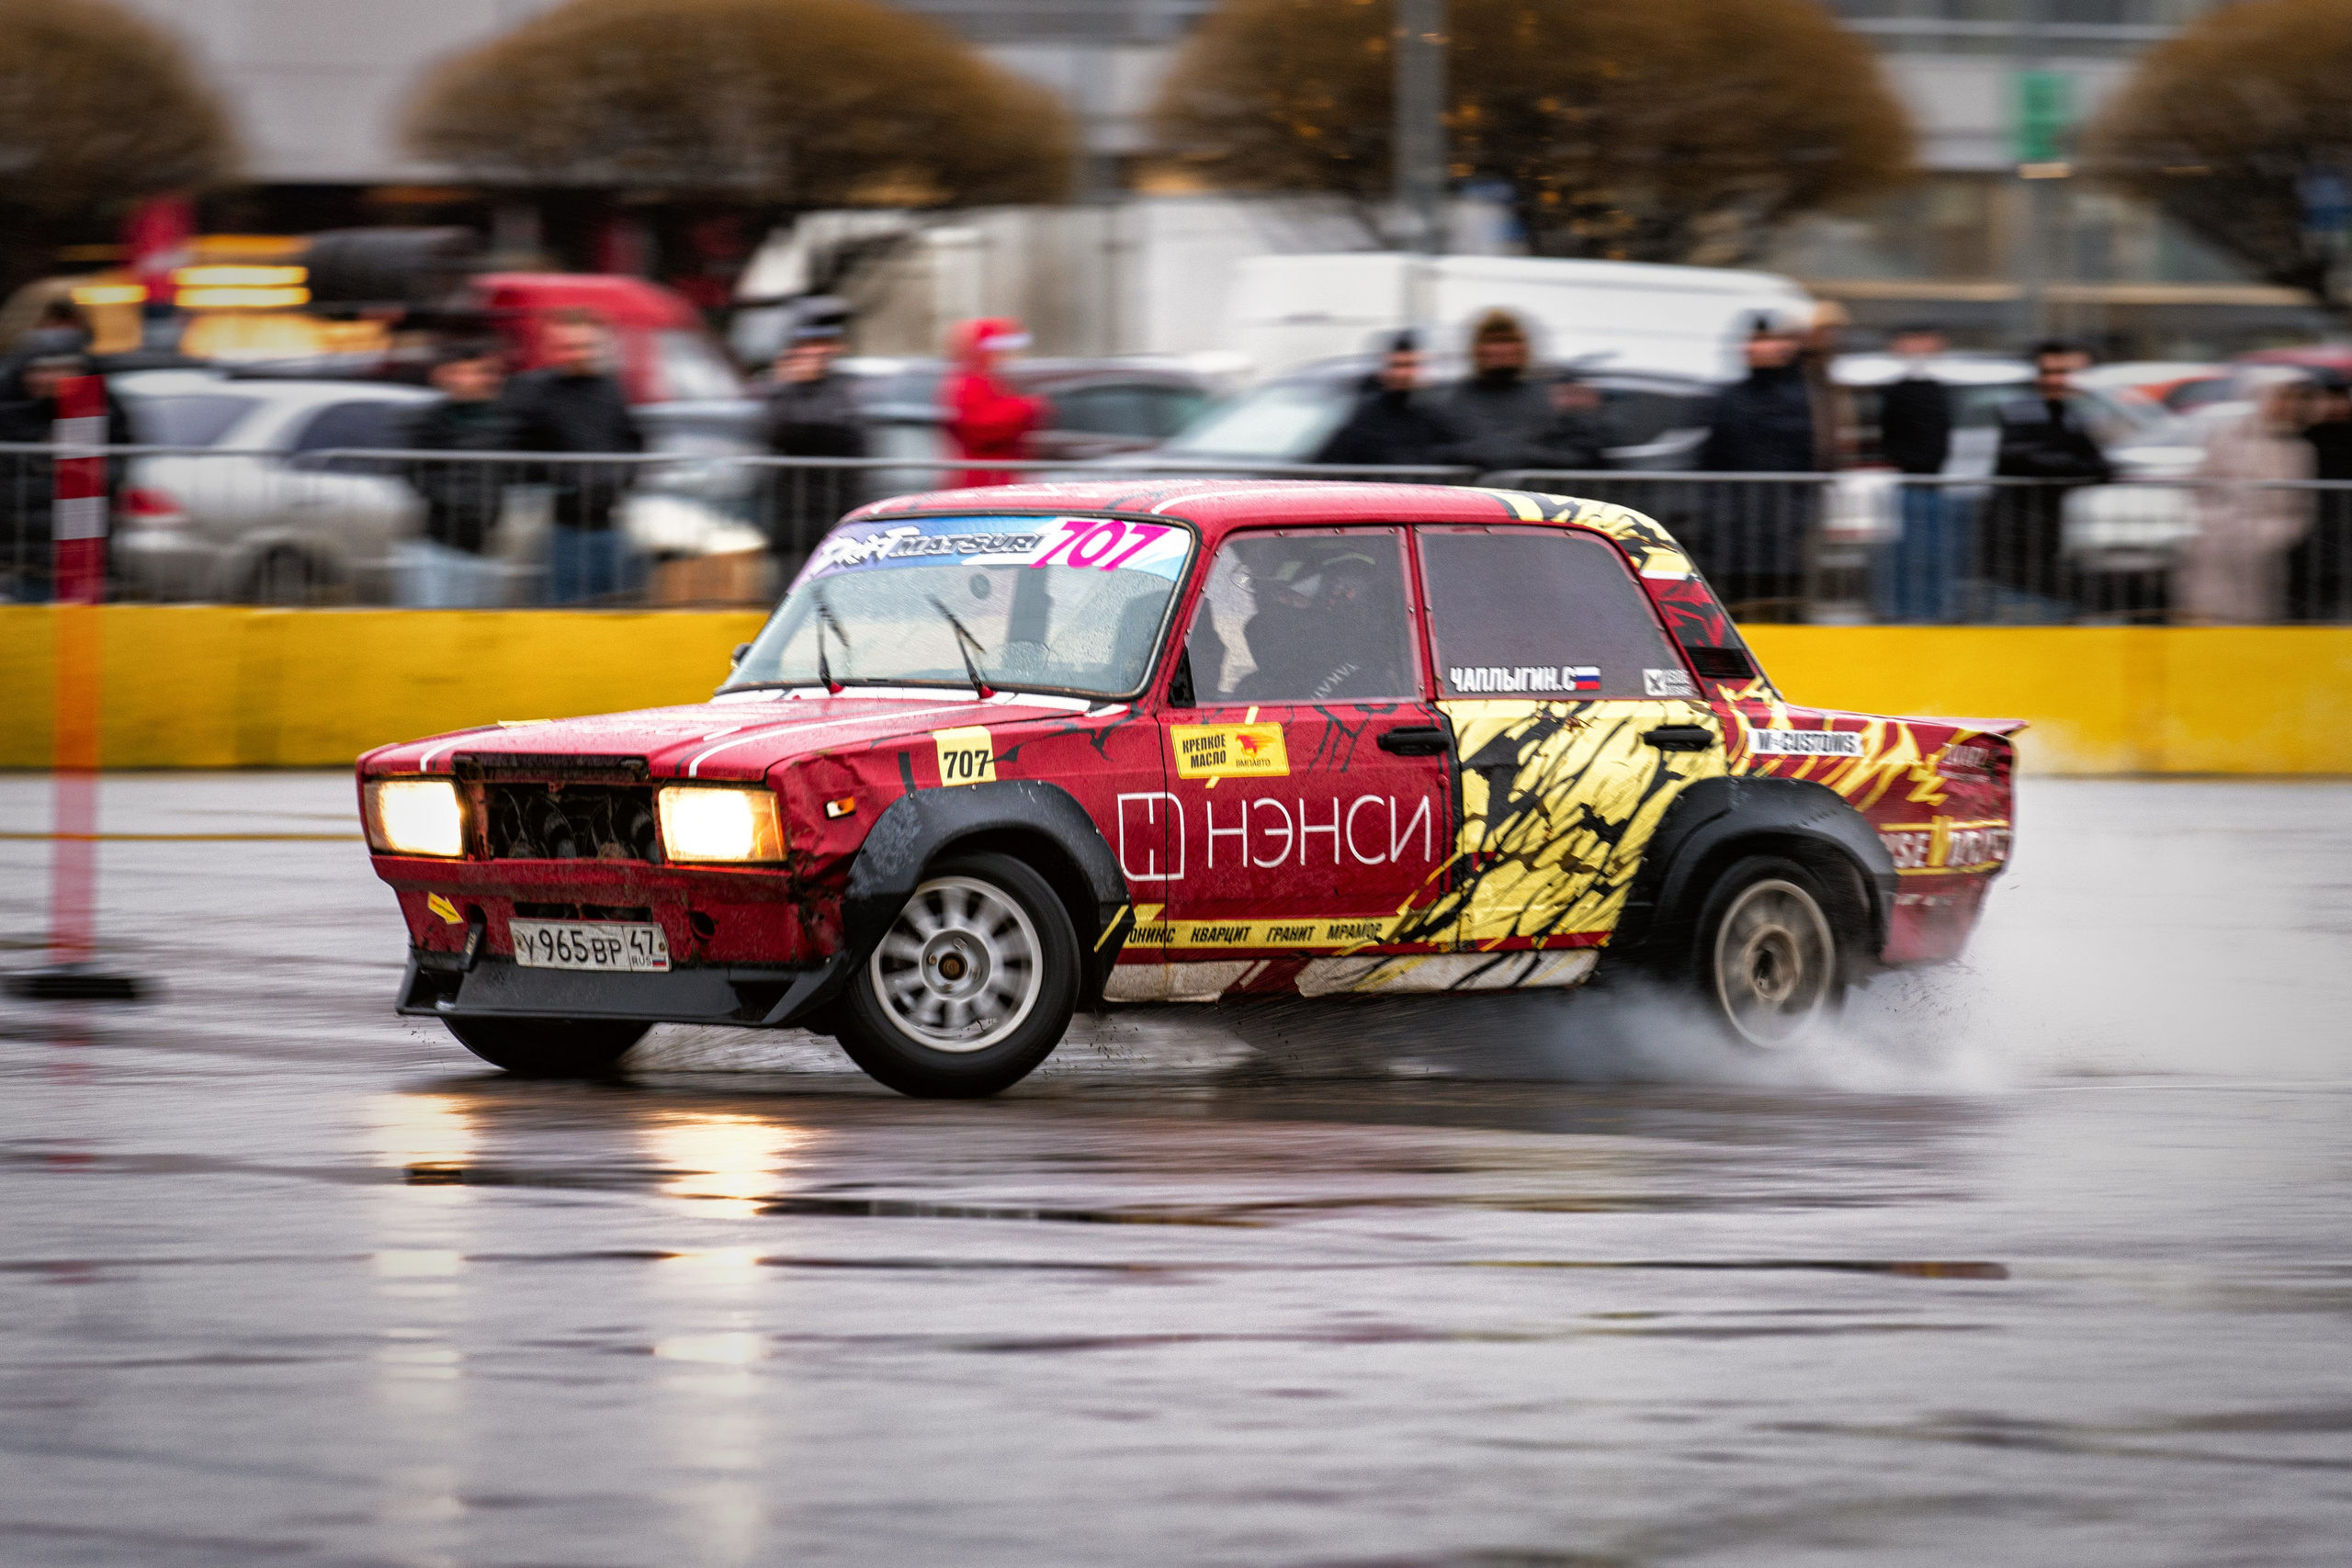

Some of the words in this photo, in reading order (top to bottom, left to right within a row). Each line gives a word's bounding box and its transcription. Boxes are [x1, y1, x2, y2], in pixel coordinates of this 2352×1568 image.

[1028, 519, 1172, 572] 707
[1450, 665, 1577, 693] ЧАПЛЫГИН.С
[1182, 734, 1227, 754] КРЕПКОЕ
[944, 750, 989, 779] 707
[1191, 750, 1227, 769] МАСЛО
[1236, 758, 1271, 768] ВМПАВТО
[1206, 795, 1431, 869] НЭНСИ
[630, 931, 653, 956] 47
[1191, 926, 1250, 945] КВАРЦИТ
[1266, 926, 1315, 942] ГРАНИТ
[631, 955, 652, 966] RUS
